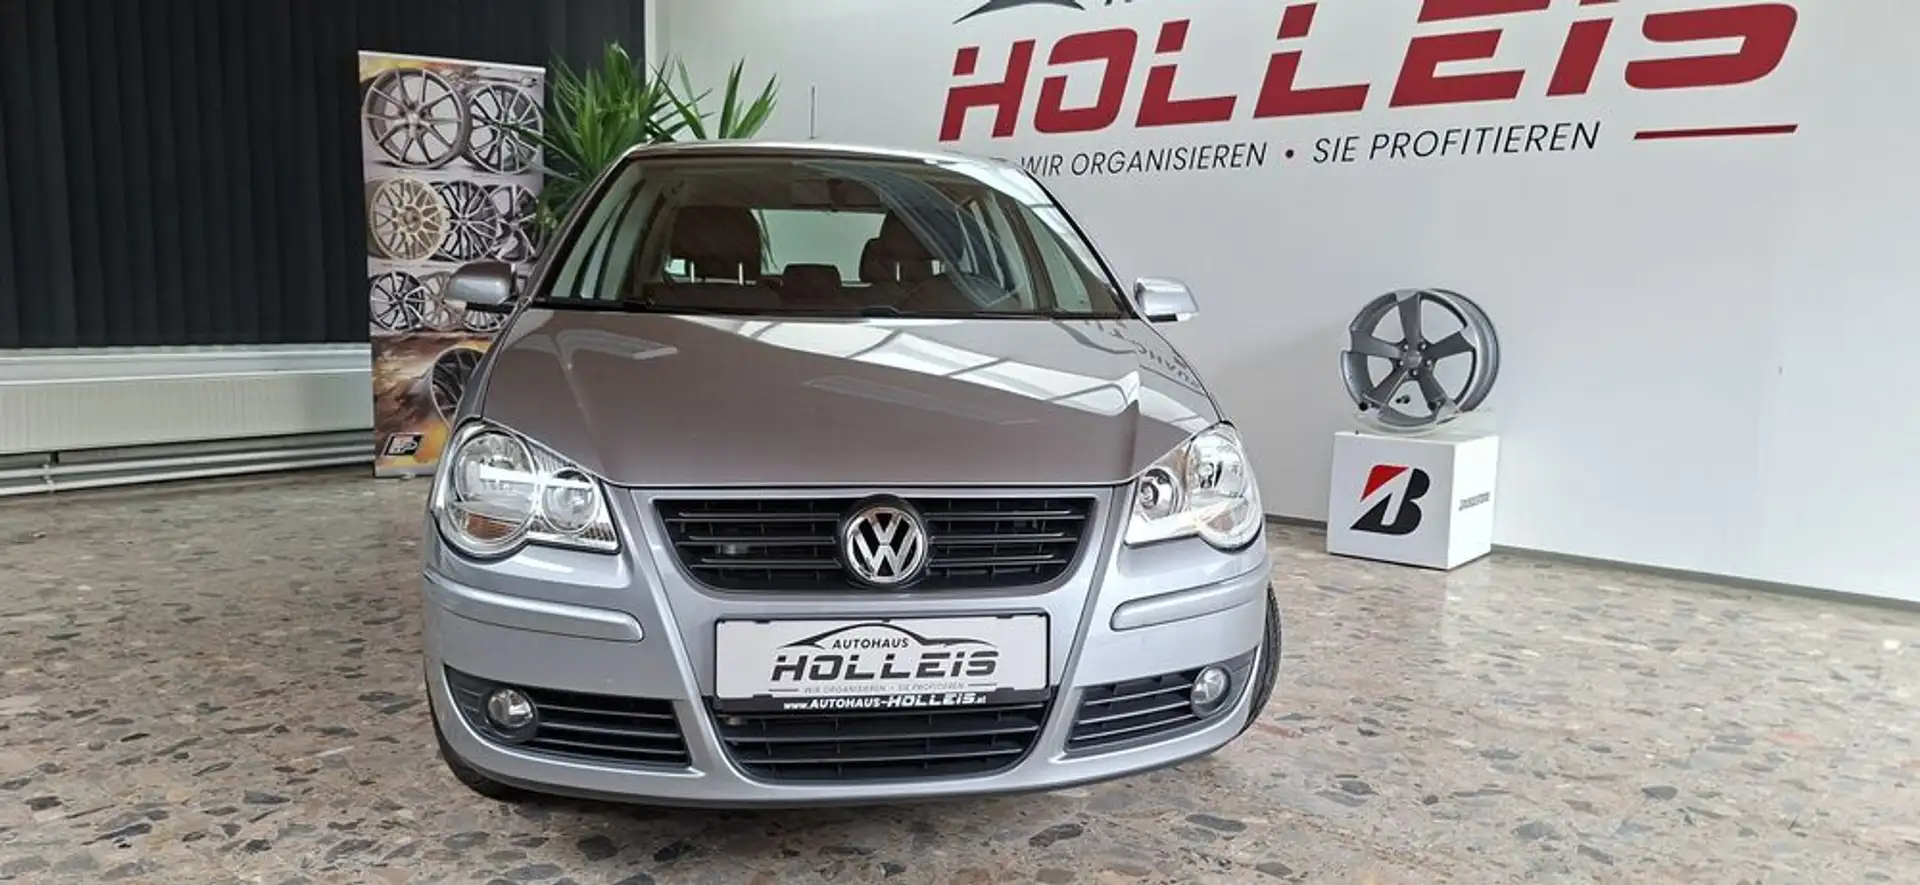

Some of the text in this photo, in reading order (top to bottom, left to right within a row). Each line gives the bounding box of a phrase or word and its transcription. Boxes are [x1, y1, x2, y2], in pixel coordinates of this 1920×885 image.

[939, 0, 1798, 141] HOLLEIS
[1020, 121, 1602, 177] WIR ORGANISIEREN SIE PROFITIEREN
[832, 637, 909, 650] AUTOHAUS
[771, 650, 999, 682] HOLLEIS
